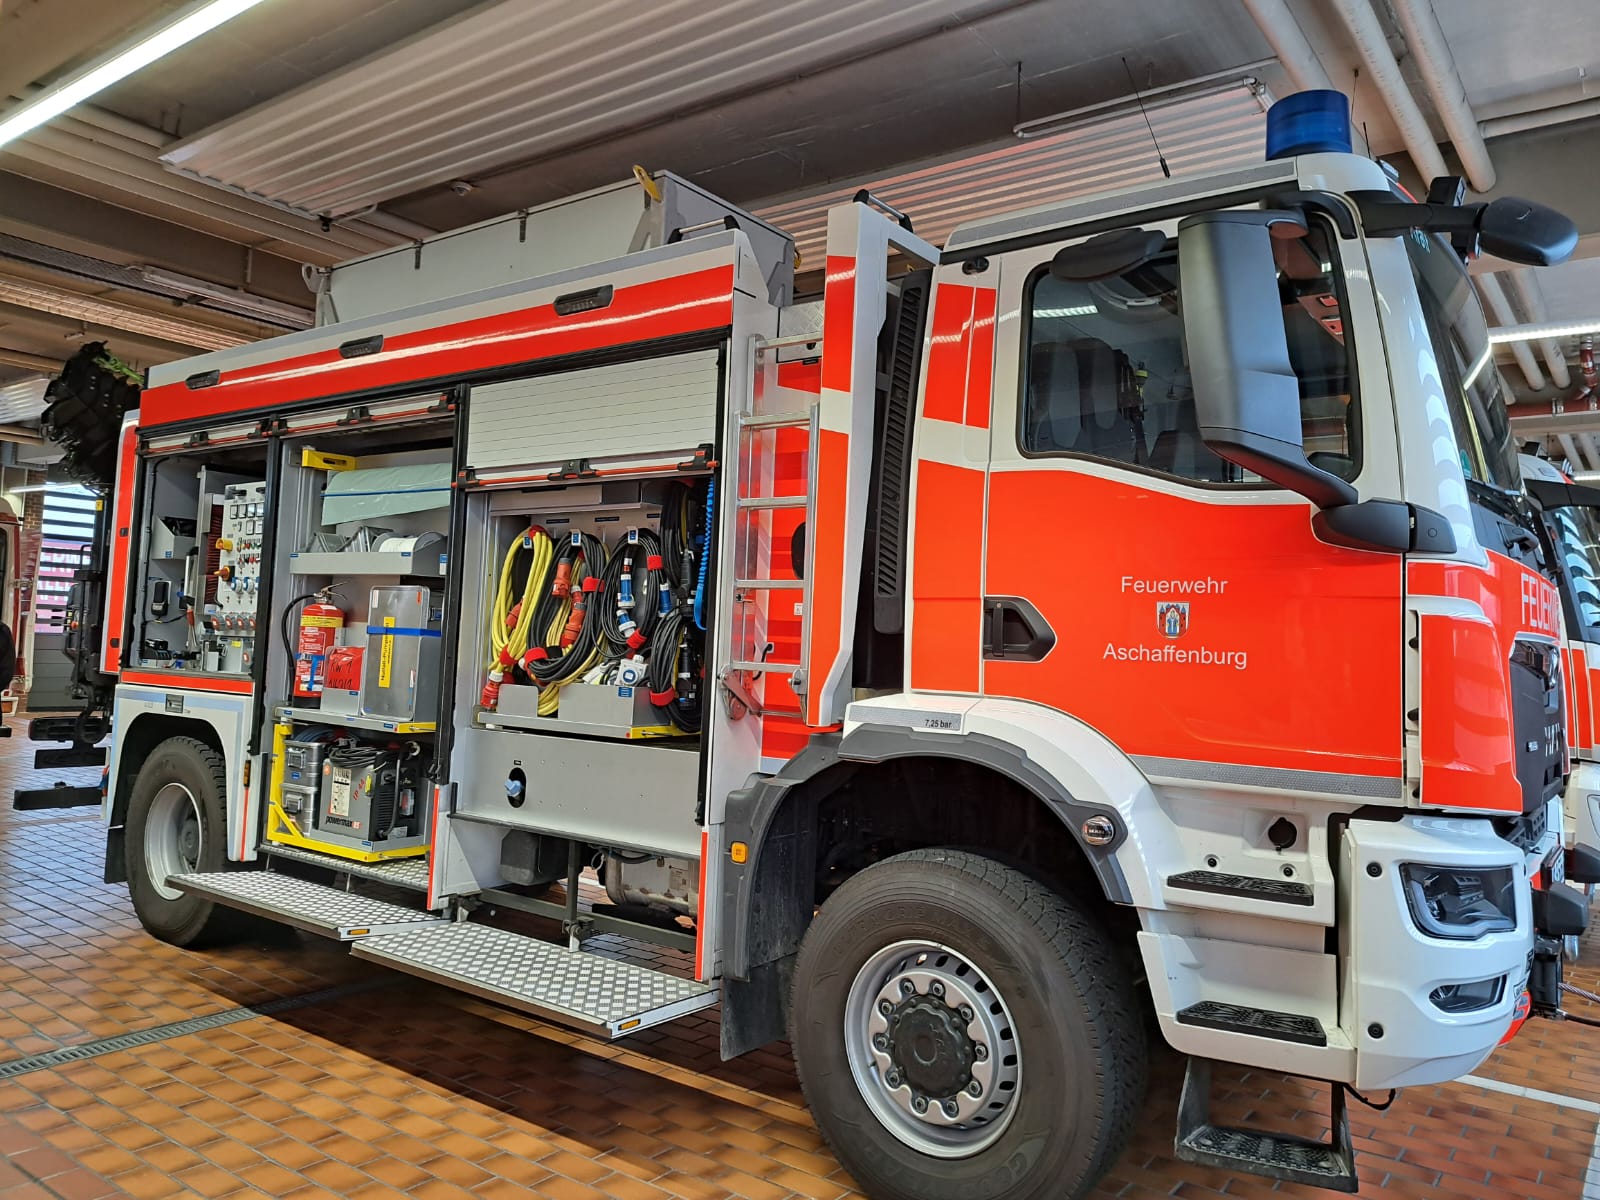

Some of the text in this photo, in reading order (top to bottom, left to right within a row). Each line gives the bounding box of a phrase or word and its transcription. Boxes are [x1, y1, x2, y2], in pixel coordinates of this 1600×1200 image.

[1121, 576, 1228, 594] Feuerwehr
[1103, 642, 1248, 670] Aschaffenburg
[925, 719, 952, 728] 7,25 bar
